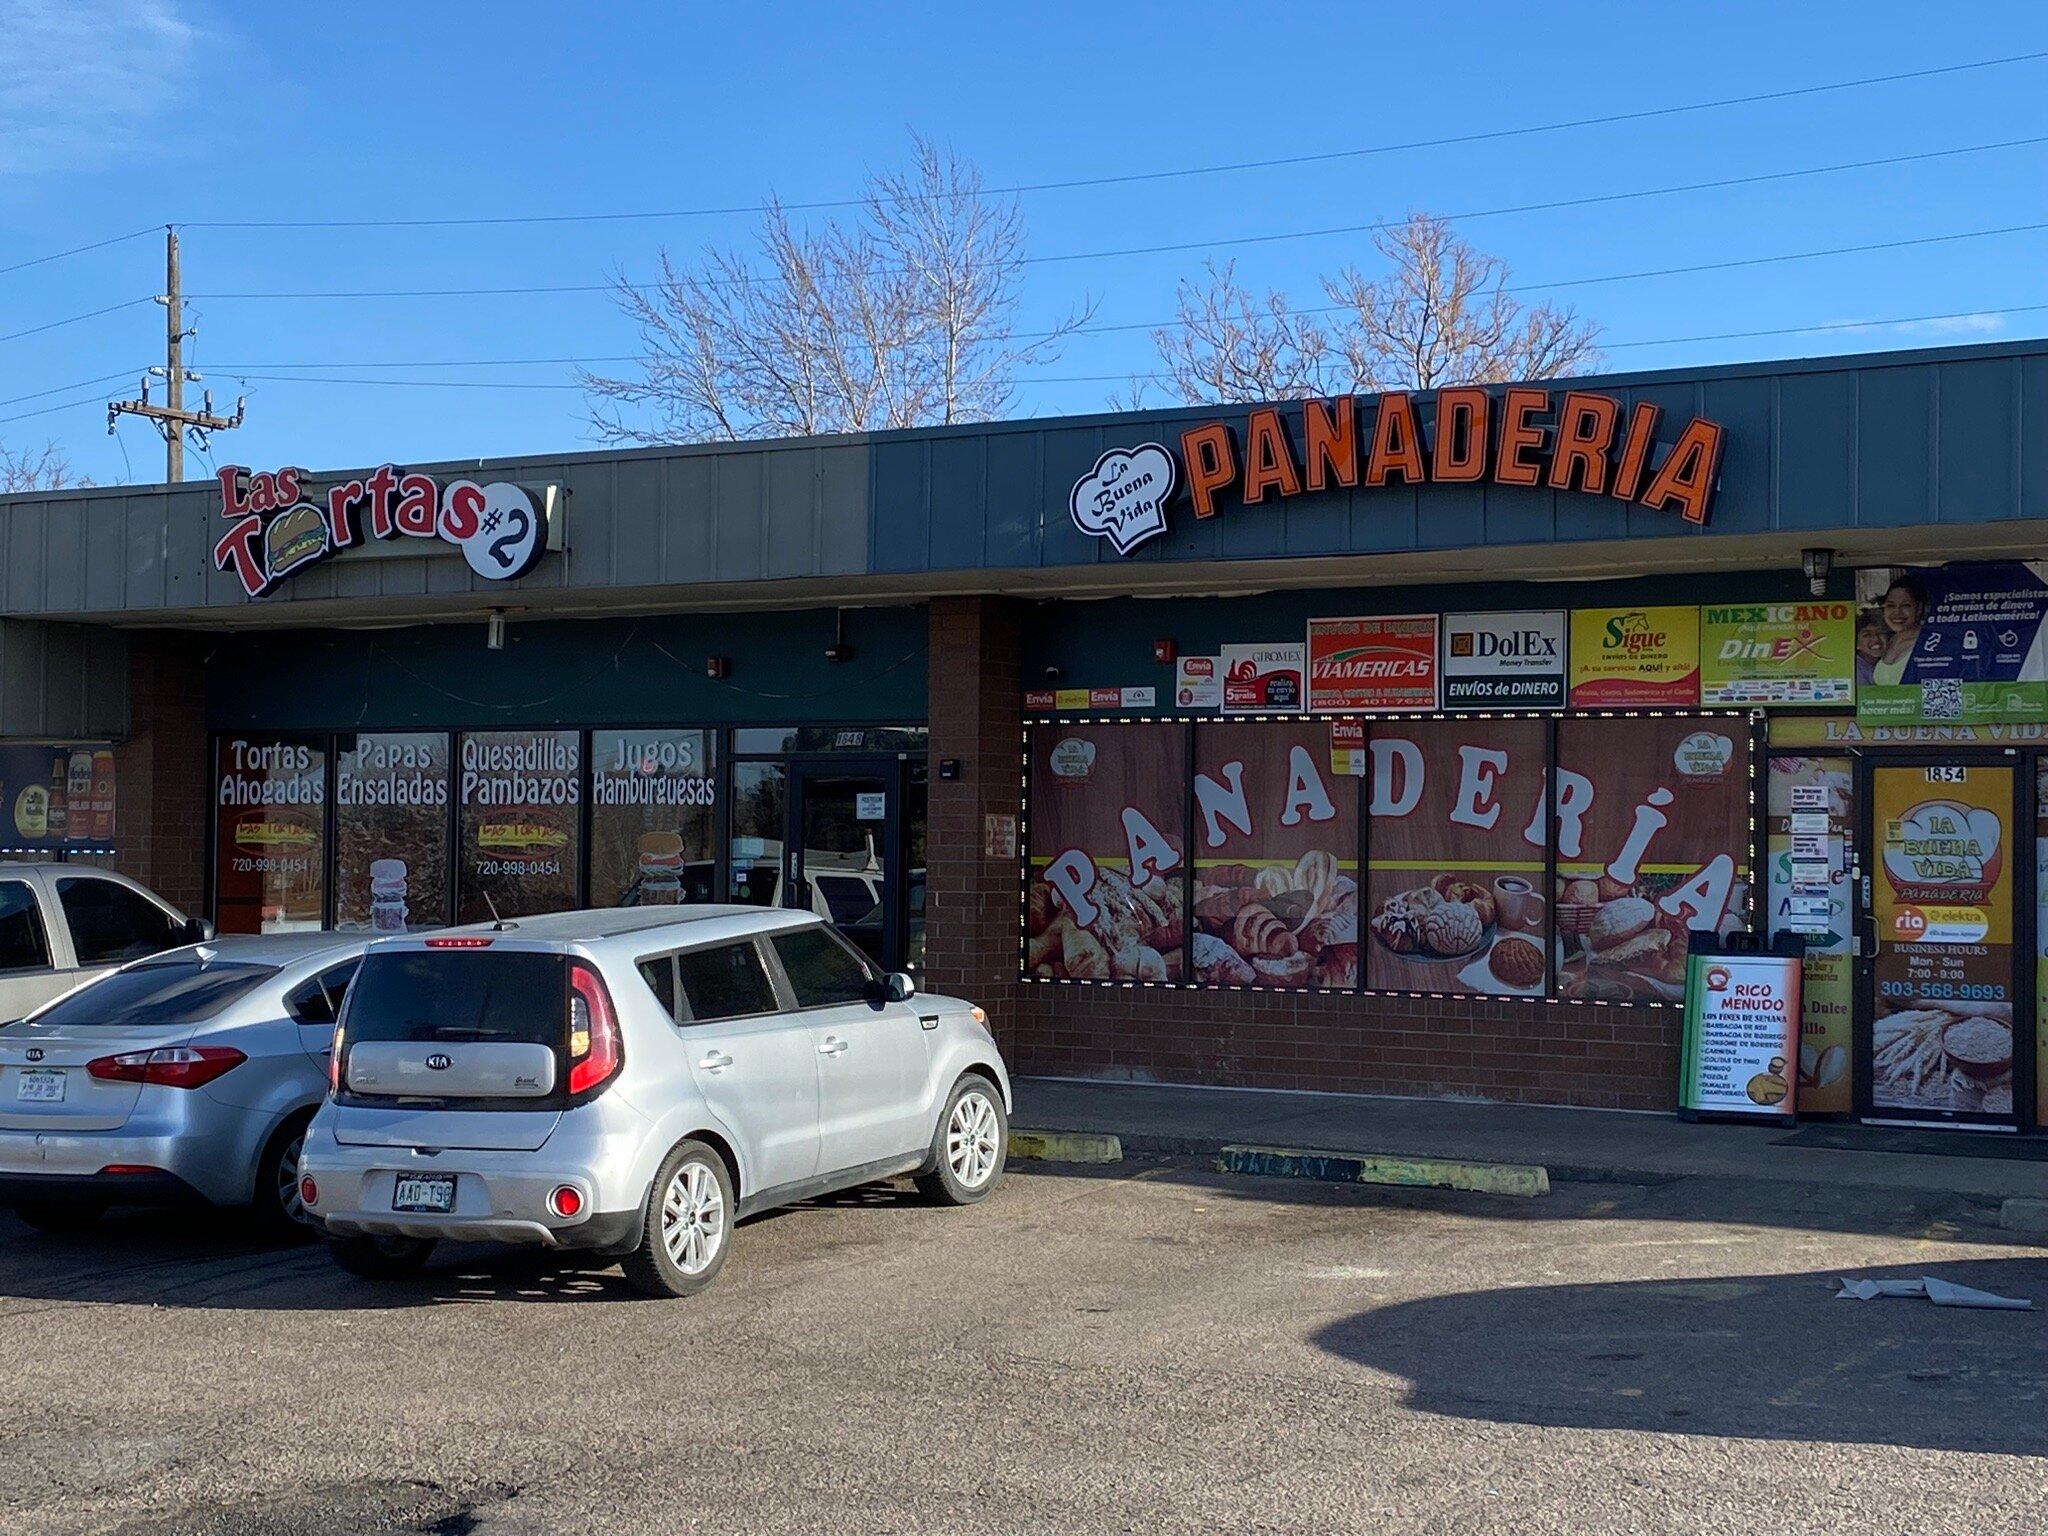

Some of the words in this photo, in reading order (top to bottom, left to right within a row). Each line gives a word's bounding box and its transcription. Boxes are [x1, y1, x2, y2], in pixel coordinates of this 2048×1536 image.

[1180, 386, 1723, 526] PANADERIA
[1102, 462, 1128, 487] La
[216, 466, 299, 518] Las
[1092, 472, 1153, 517] Buena
[1102, 501, 1153, 532] Vida
[2000, 601, 2034, 610] dinero
[1707, 605, 1848, 624] MEXICANO
[1937, 614, 1960, 623] toda
[1603, 616, 1666, 653] Sigue
[1478, 630, 1557, 657] DolEx
[1253, 651, 1301, 662] GIROMEX
[1499, 659, 1522, 668] Money
[1312, 660, 1432, 679] VIAMERICAS
[1226, 689, 1234, 700] 5
[1450, 681, 1493, 697] ENVÍOS
[1494, 683, 1510, 696] de
[1512, 682, 1559, 696] DINERO
[1333, 722, 1363, 737] Envía
[1827, 721, 1862, 740] LA
[1873, 725, 1977, 740] BUENA
[1988, 724, 2048, 740] VID
[837, 733, 862, 745] 1848
[231, 740, 309, 770] Tortas
[356, 739, 430, 768] Papas
[462, 737, 578, 771] Quesadillas
[615, 739, 693, 772] Jugos
[1926, 768, 1964, 781] 1854
[220, 774, 324, 805] Ahogadas
[337, 774, 447, 805] Ensaladas
[461, 773, 579, 806] Pambazos
[593, 775, 715, 807] Hamburguesas
[1930, 816, 1956, 834] LA
[1904, 839, 1983, 856] BUENA
[232, 858, 308, 872] 720-998-0454
[476, 861, 560, 875] 720-998-0454
[1913, 861, 1973, 878] VIDA
[1901, 887, 1983, 901] PANADERIA
[1895, 910, 1923, 928] ria
[1942, 910, 1981, 921] elektra
[1894, 944, 1945, 954] BUSINESS
[1948, 945, 1988, 956] HOURS
[1910, 956, 1934, 967] Mon
[1942, 957, 1964, 967] Sun
[1907, 968, 1931, 979] 7:00
[1940, 969, 1964, 979] 9:00
[1735, 984, 1771, 997] RICO
[1880, 981, 2006, 999] 303-568-9693
[1721, 998, 1784, 1011] MENUDO
[1812, 1001, 1847, 1014] Dulce
[1754, 1015, 1787, 1023] SEMANA
[28, 1050, 43, 1060] KIA
[427, 1056, 449, 1067] KIA
